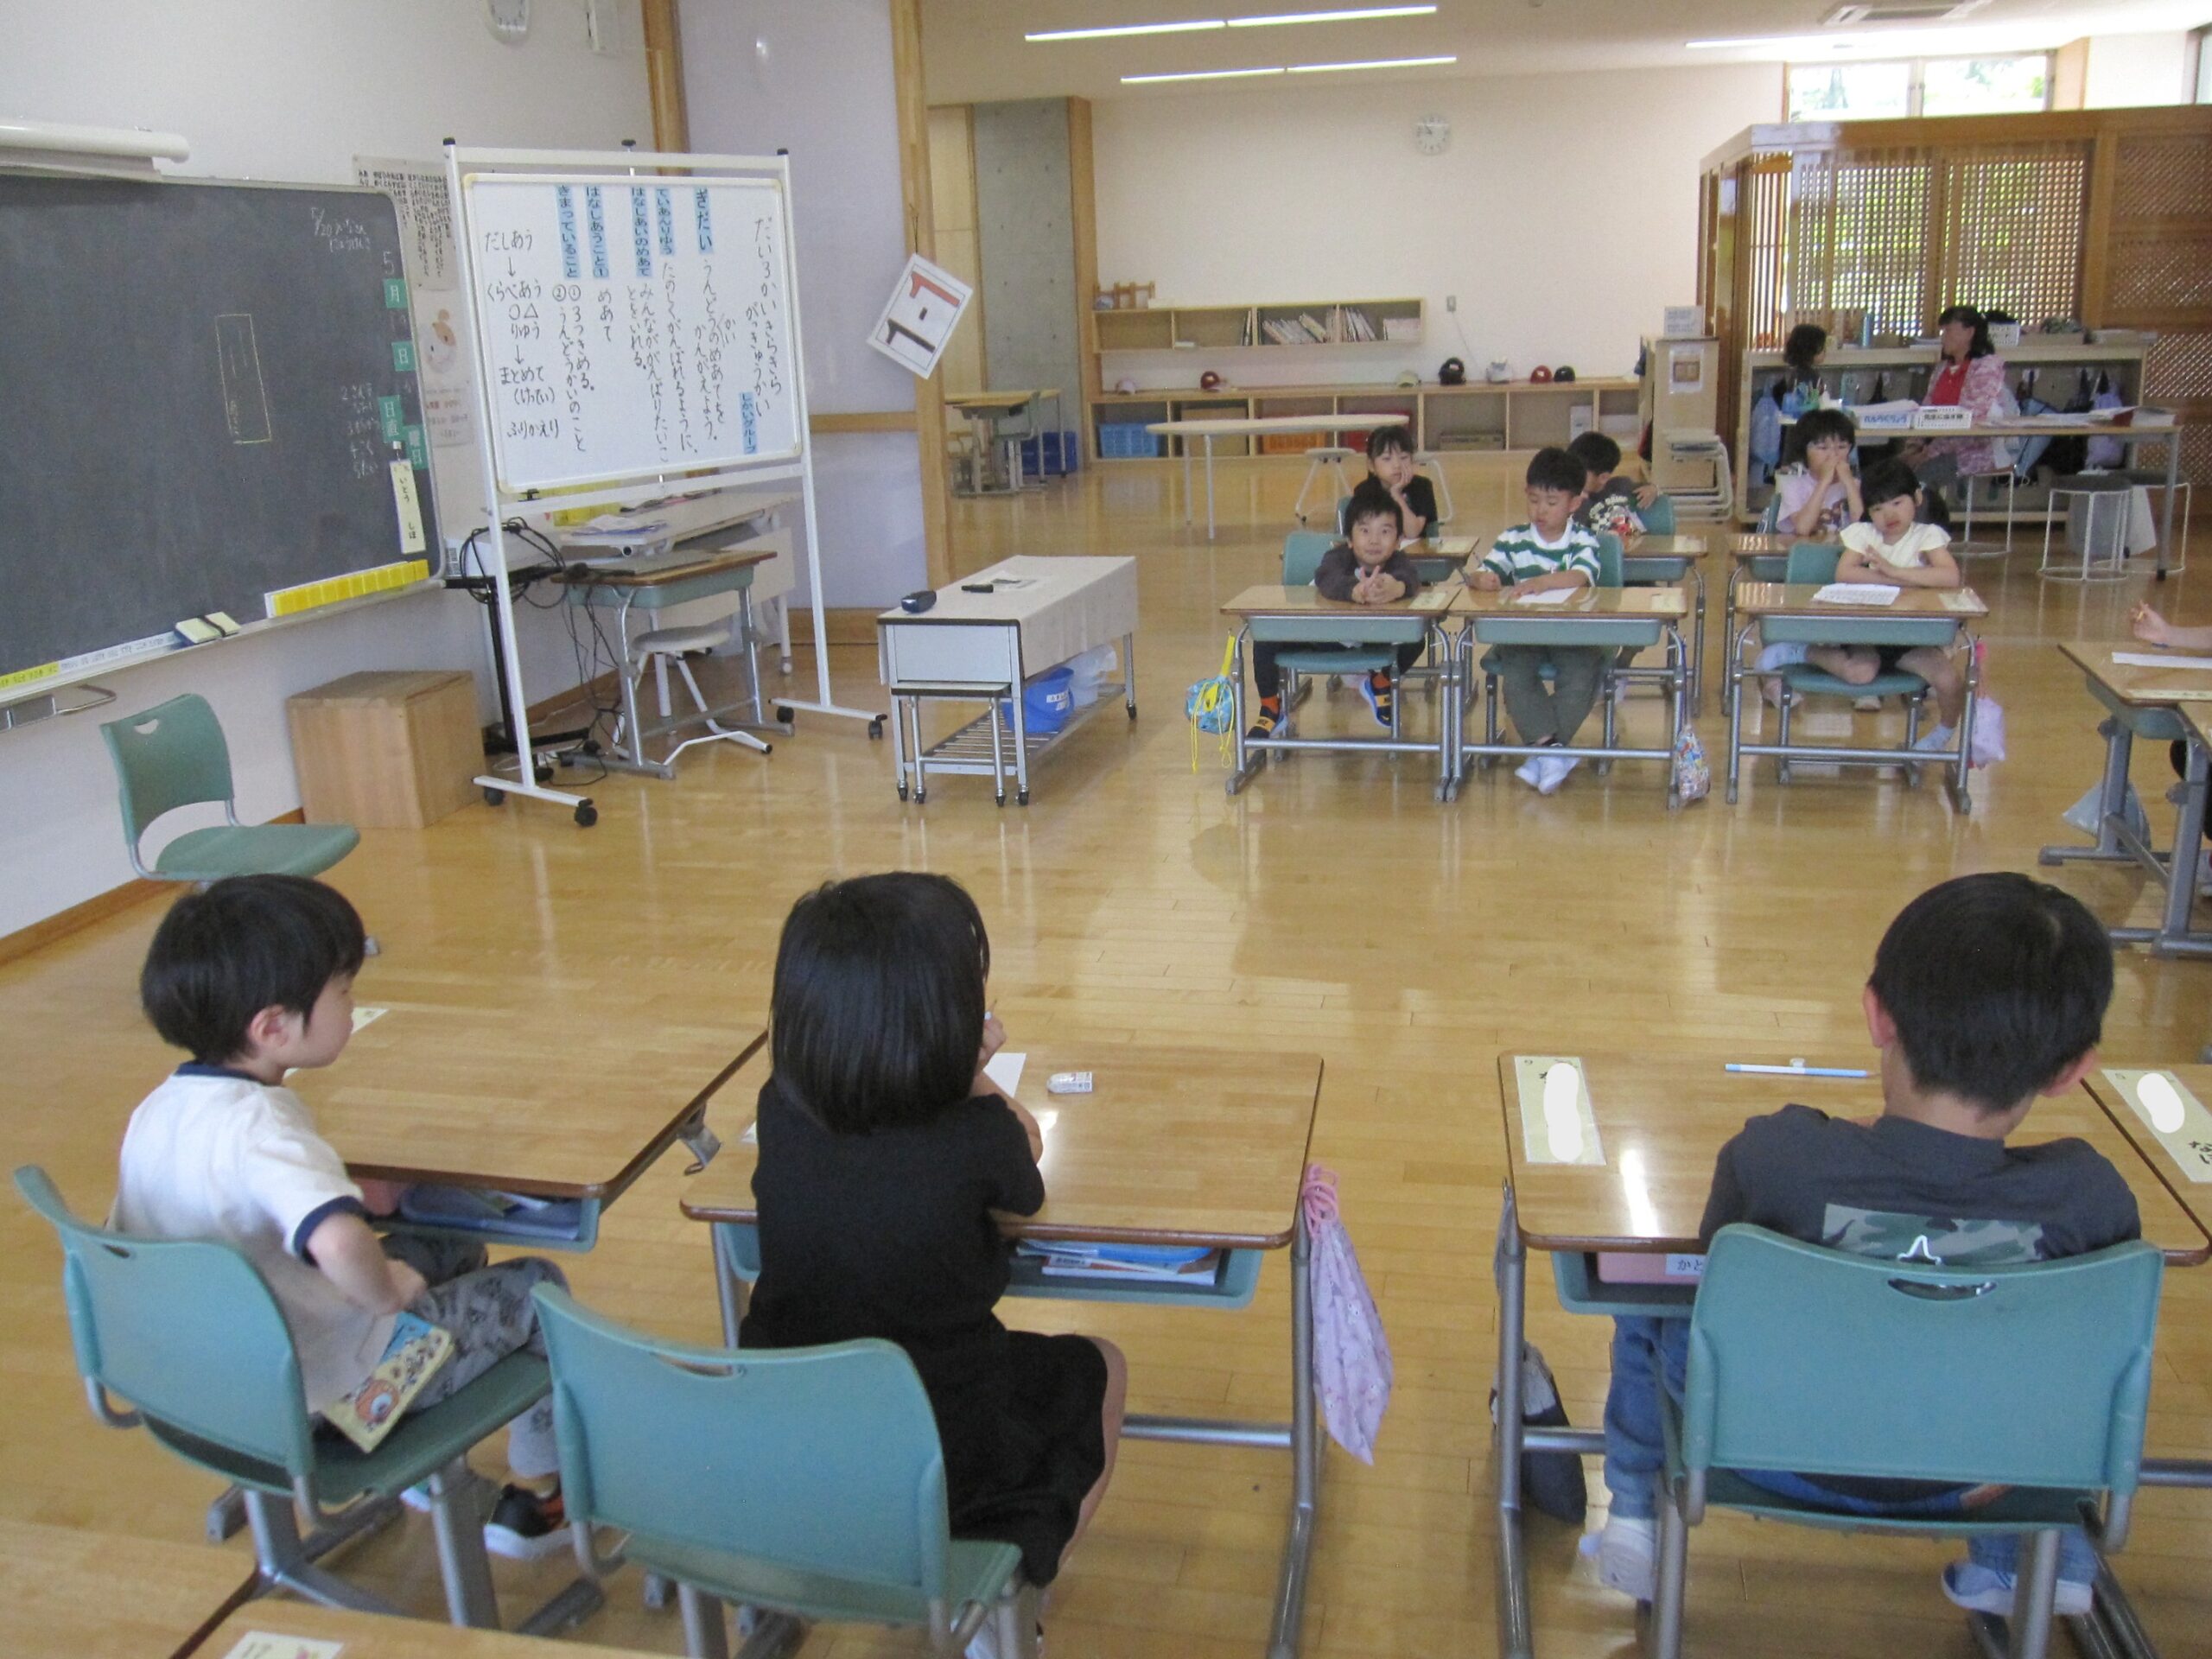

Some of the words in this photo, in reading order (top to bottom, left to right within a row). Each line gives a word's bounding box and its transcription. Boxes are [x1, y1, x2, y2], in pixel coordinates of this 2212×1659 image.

[485, 229, 533, 252] だしあう
[558, 185, 577, 277] きまっていること
[632, 186, 650, 276] はなしあいのめあて
[696, 188, 713, 251] ぎだい
[487, 277, 542, 302] くらべあう
[597, 289, 614, 343] めあて
[390, 284, 400, 302] 月
[398, 347, 409, 365] 日
[499, 365, 544, 385] まとめて
[506, 418, 559, 440] ふりかえり
